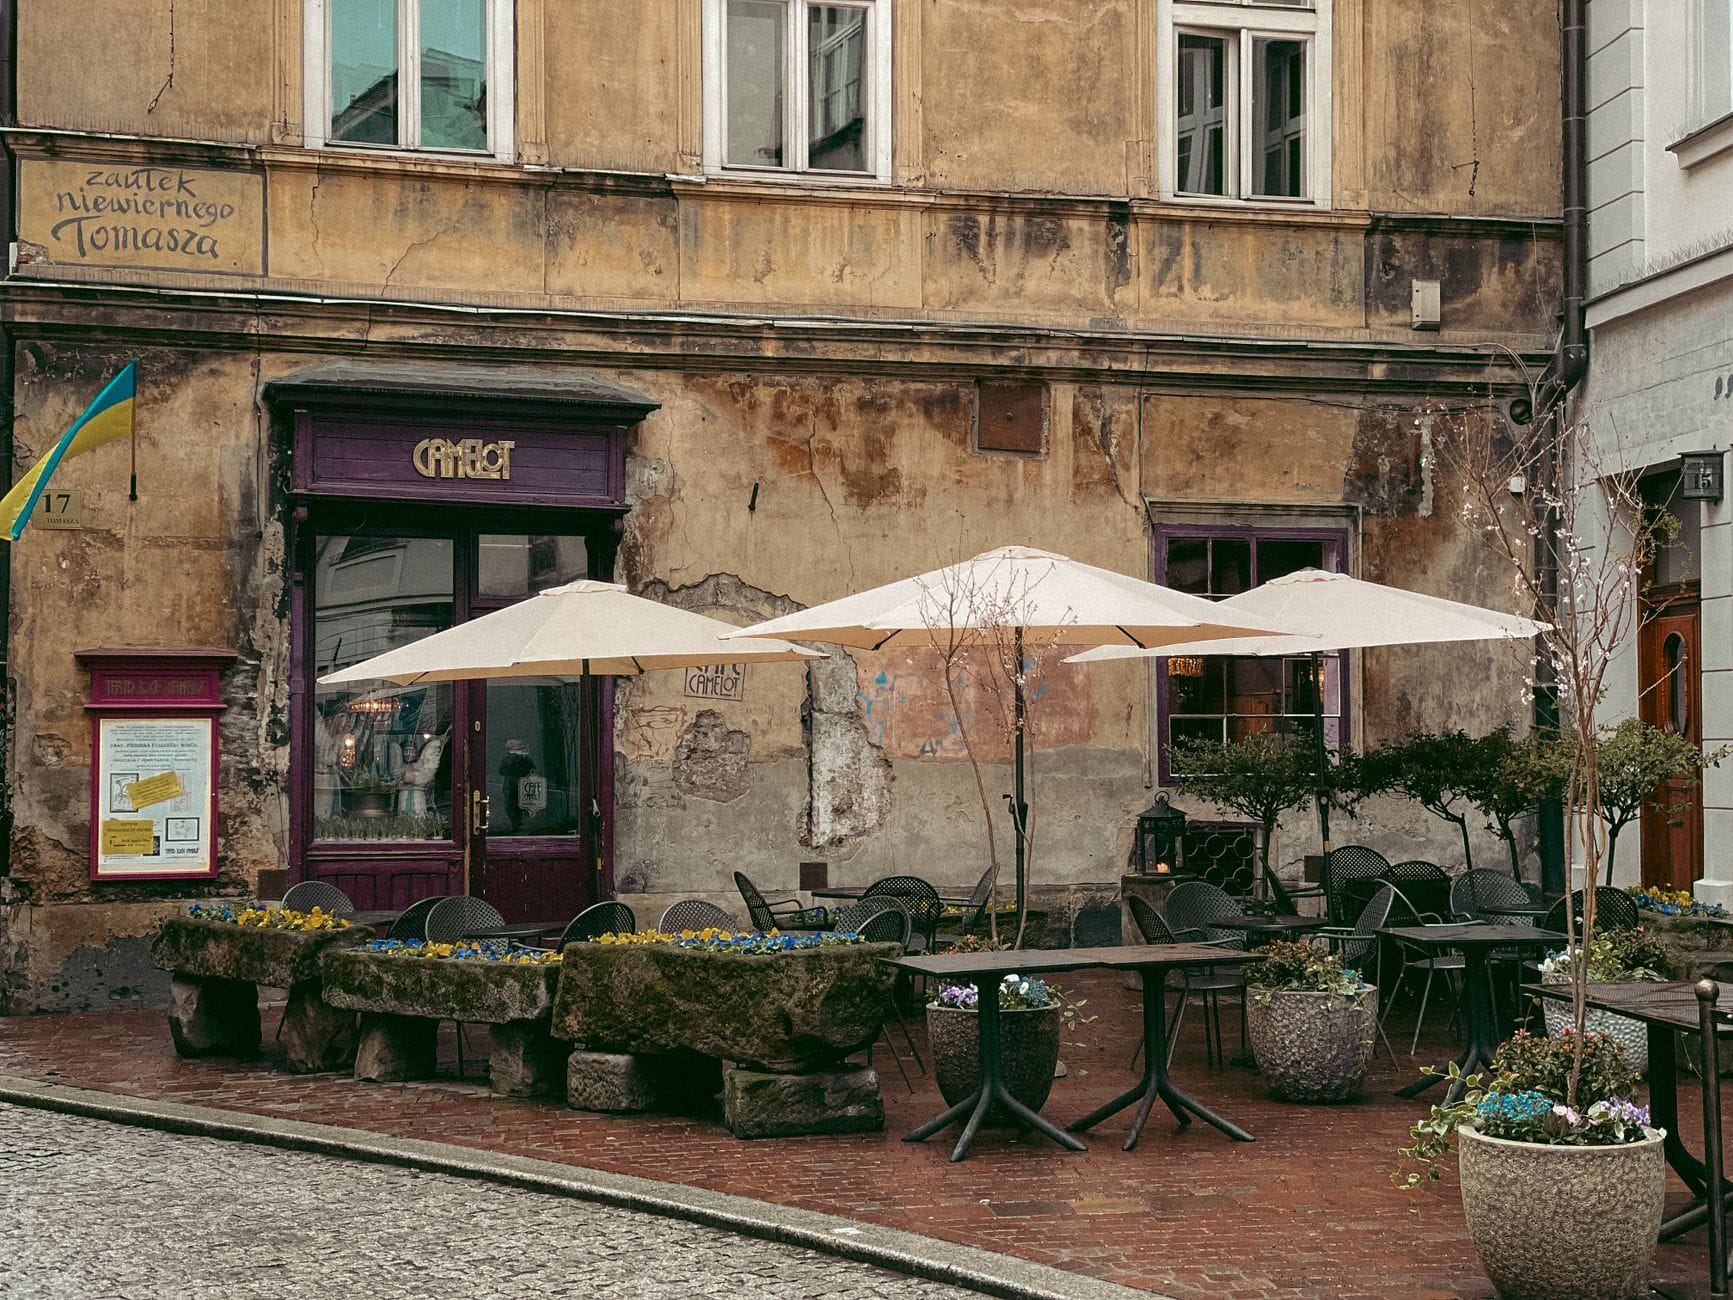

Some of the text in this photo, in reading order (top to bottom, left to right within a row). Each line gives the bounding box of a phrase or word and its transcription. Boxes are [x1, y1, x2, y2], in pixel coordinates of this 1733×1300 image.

[57, 187, 235, 227] niewiernego
[51, 215, 219, 259] Tomasza
[412, 438, 516, 480] CAMELOT
[1694, 472, 1712, 489] 15
[42, 494, 71, 513] 17
[688, 673, 741, 698] CAMELOT
